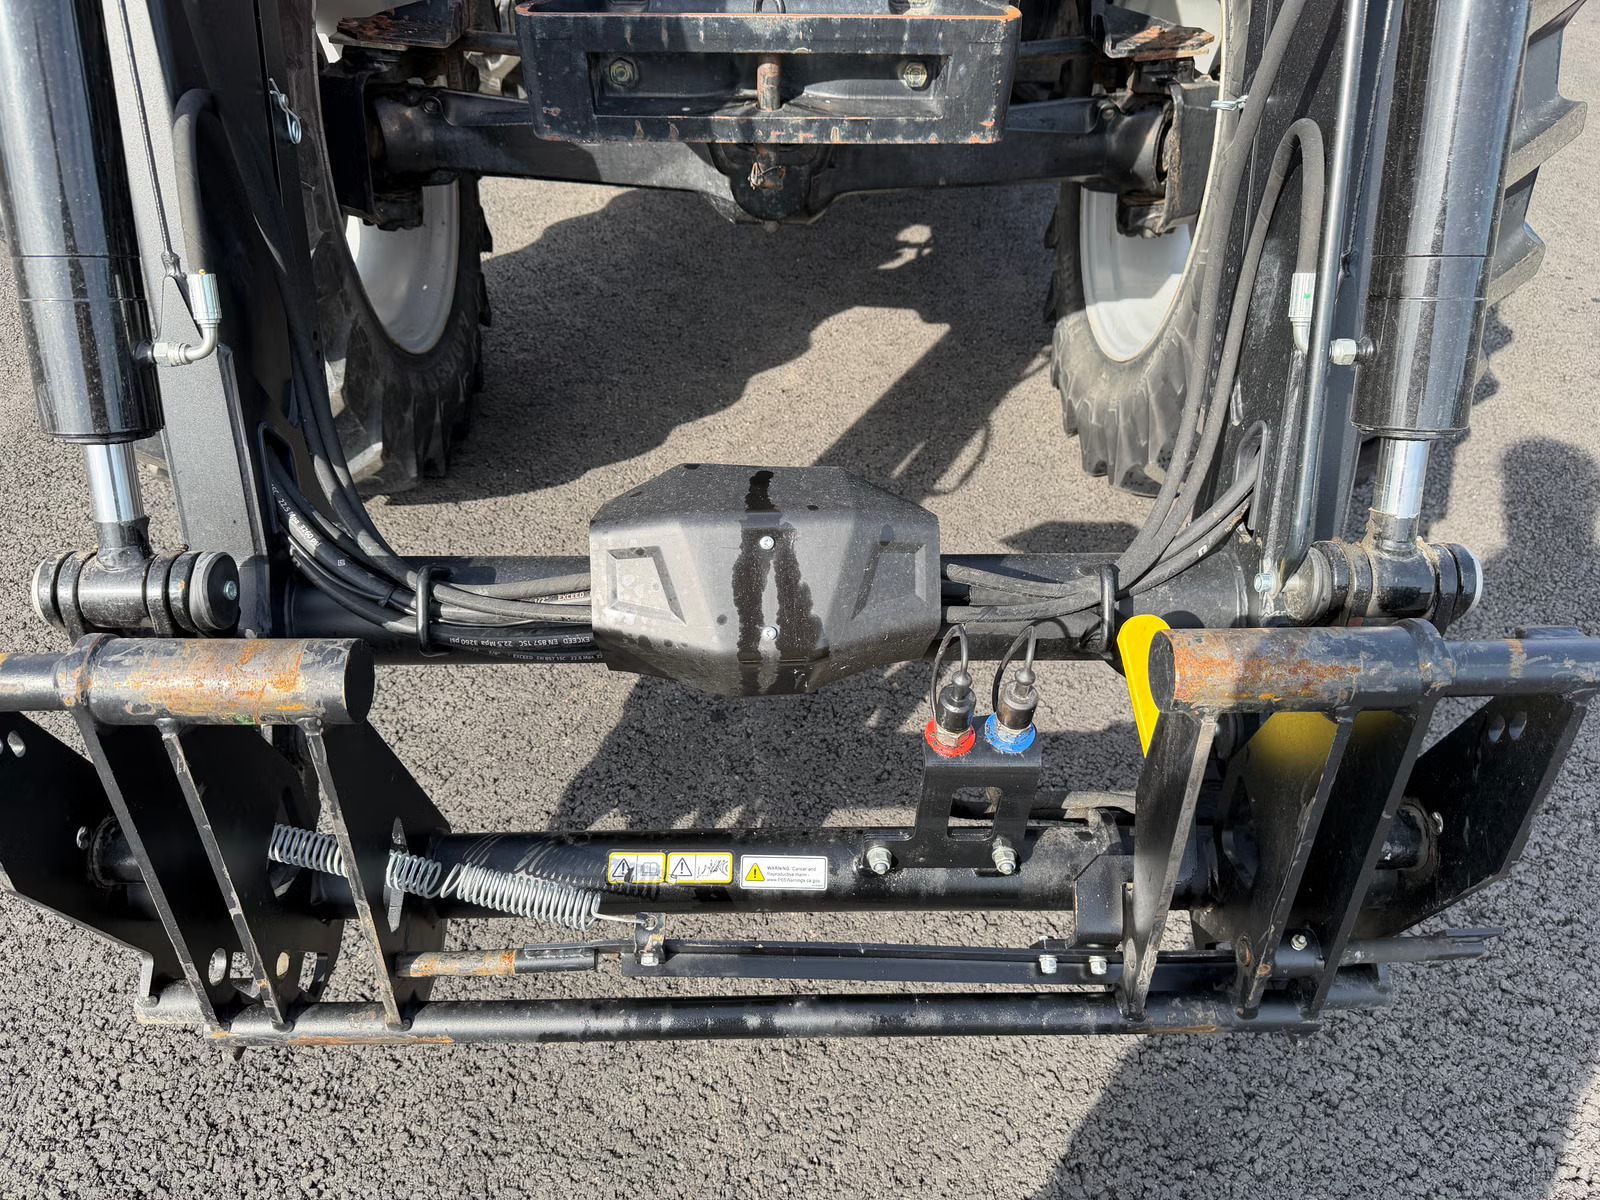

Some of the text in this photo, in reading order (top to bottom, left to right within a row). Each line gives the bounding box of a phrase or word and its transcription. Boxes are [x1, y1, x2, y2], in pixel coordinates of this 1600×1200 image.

[278, 498, 291, 512] 22.5
[299, 524, 315, 539] 3260
[557, 592, 585, 600] EXCEED
[460, 638, 479, 646] 3260
[480, 639, 496, 647] Mpa
[562, 636, 591, 644] EXCEED
